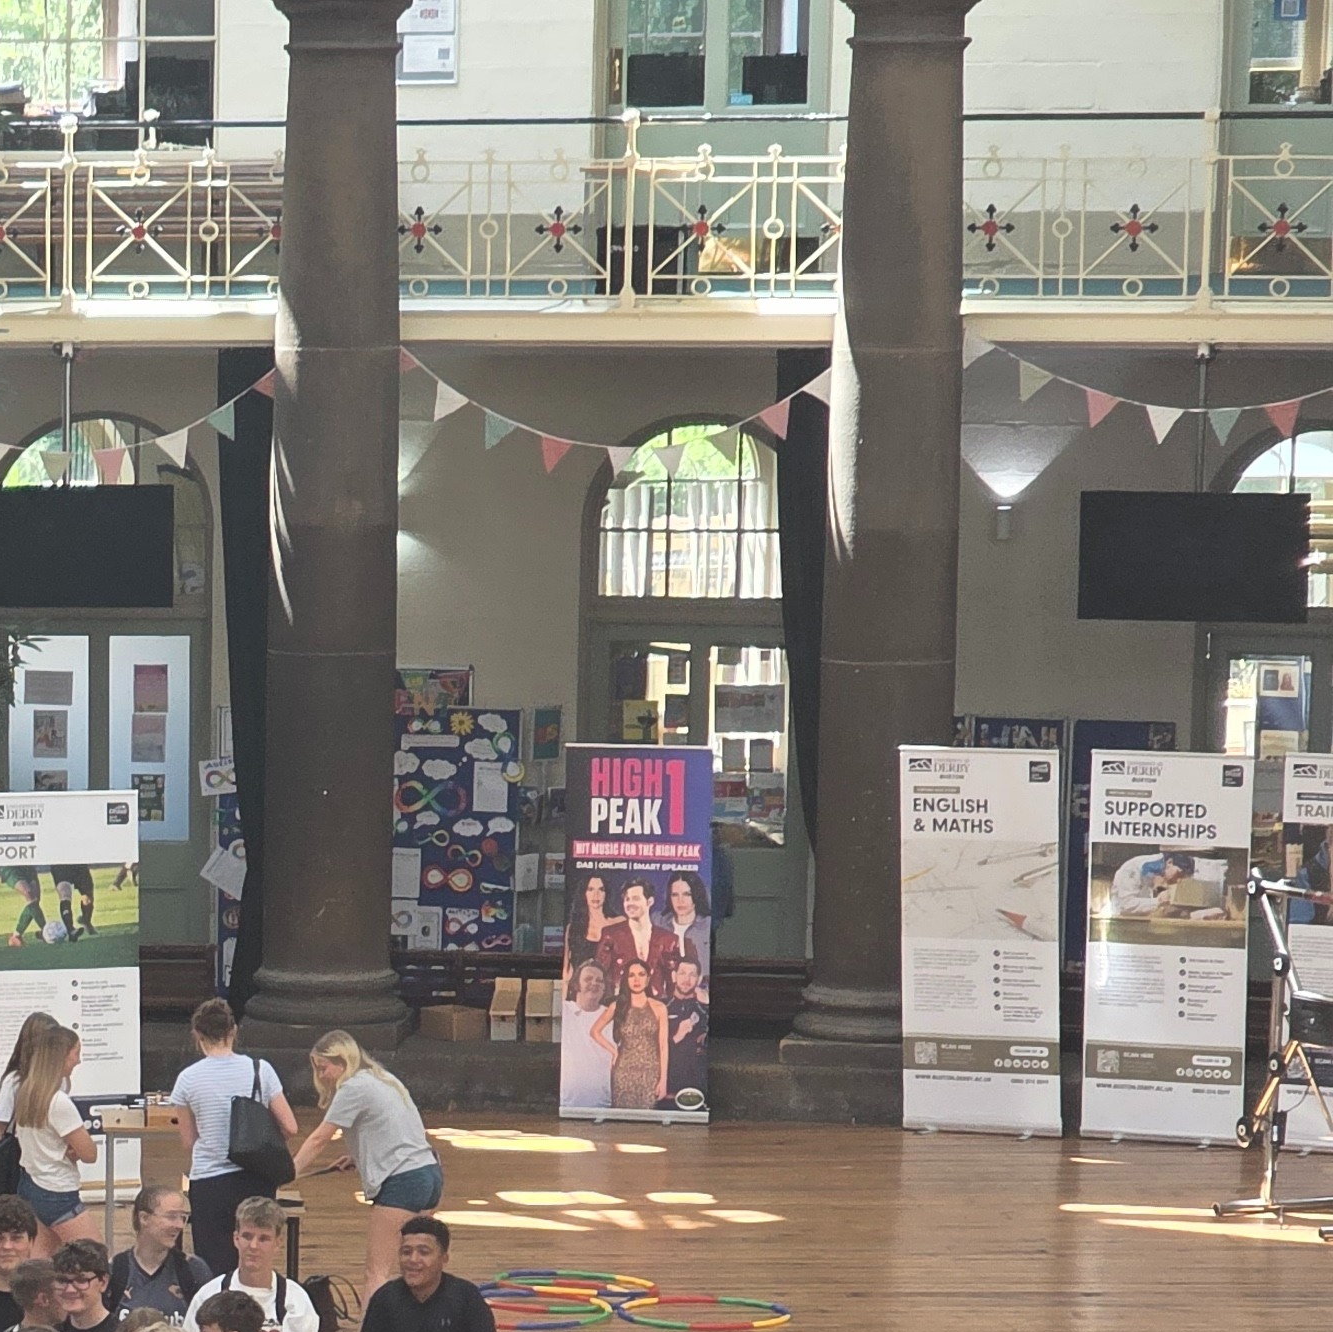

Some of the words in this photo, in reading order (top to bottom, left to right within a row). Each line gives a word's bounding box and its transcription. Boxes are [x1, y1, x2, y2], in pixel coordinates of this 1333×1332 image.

[934, 762, 970, 773] DERBY
[1127, 765, 1163, 777] DERBY
[591, 757, 663, 798] HIGH
[665, 759, 686, 835] 1
[6, 808, 45, 819] DERBY
[913, 797, 989, 814] ENGLISH
[1104, 800, 1208, 819] SUPPORTED
[1295, 804, 1333, 818] TRAI
[590, 797, 663, 835] PEAK
[913, 817, 925, 832] &
[932, 818, 994, 834] MATHS
[1104, 820, 1217, 840] INTERNSHIPS
[575, 842, 590, 855] HIT
[591, 843, 619, 856] MUSIC
[620, 843, 637, 856] FOR
[638, 844, 654, 857] THE
[655, 844, 676, 857] HIGH
[677, 844, 702, 858] PEAK
[633, 863, 660, 871] SMART
[661, 863, 699, 872] SPEAKER
